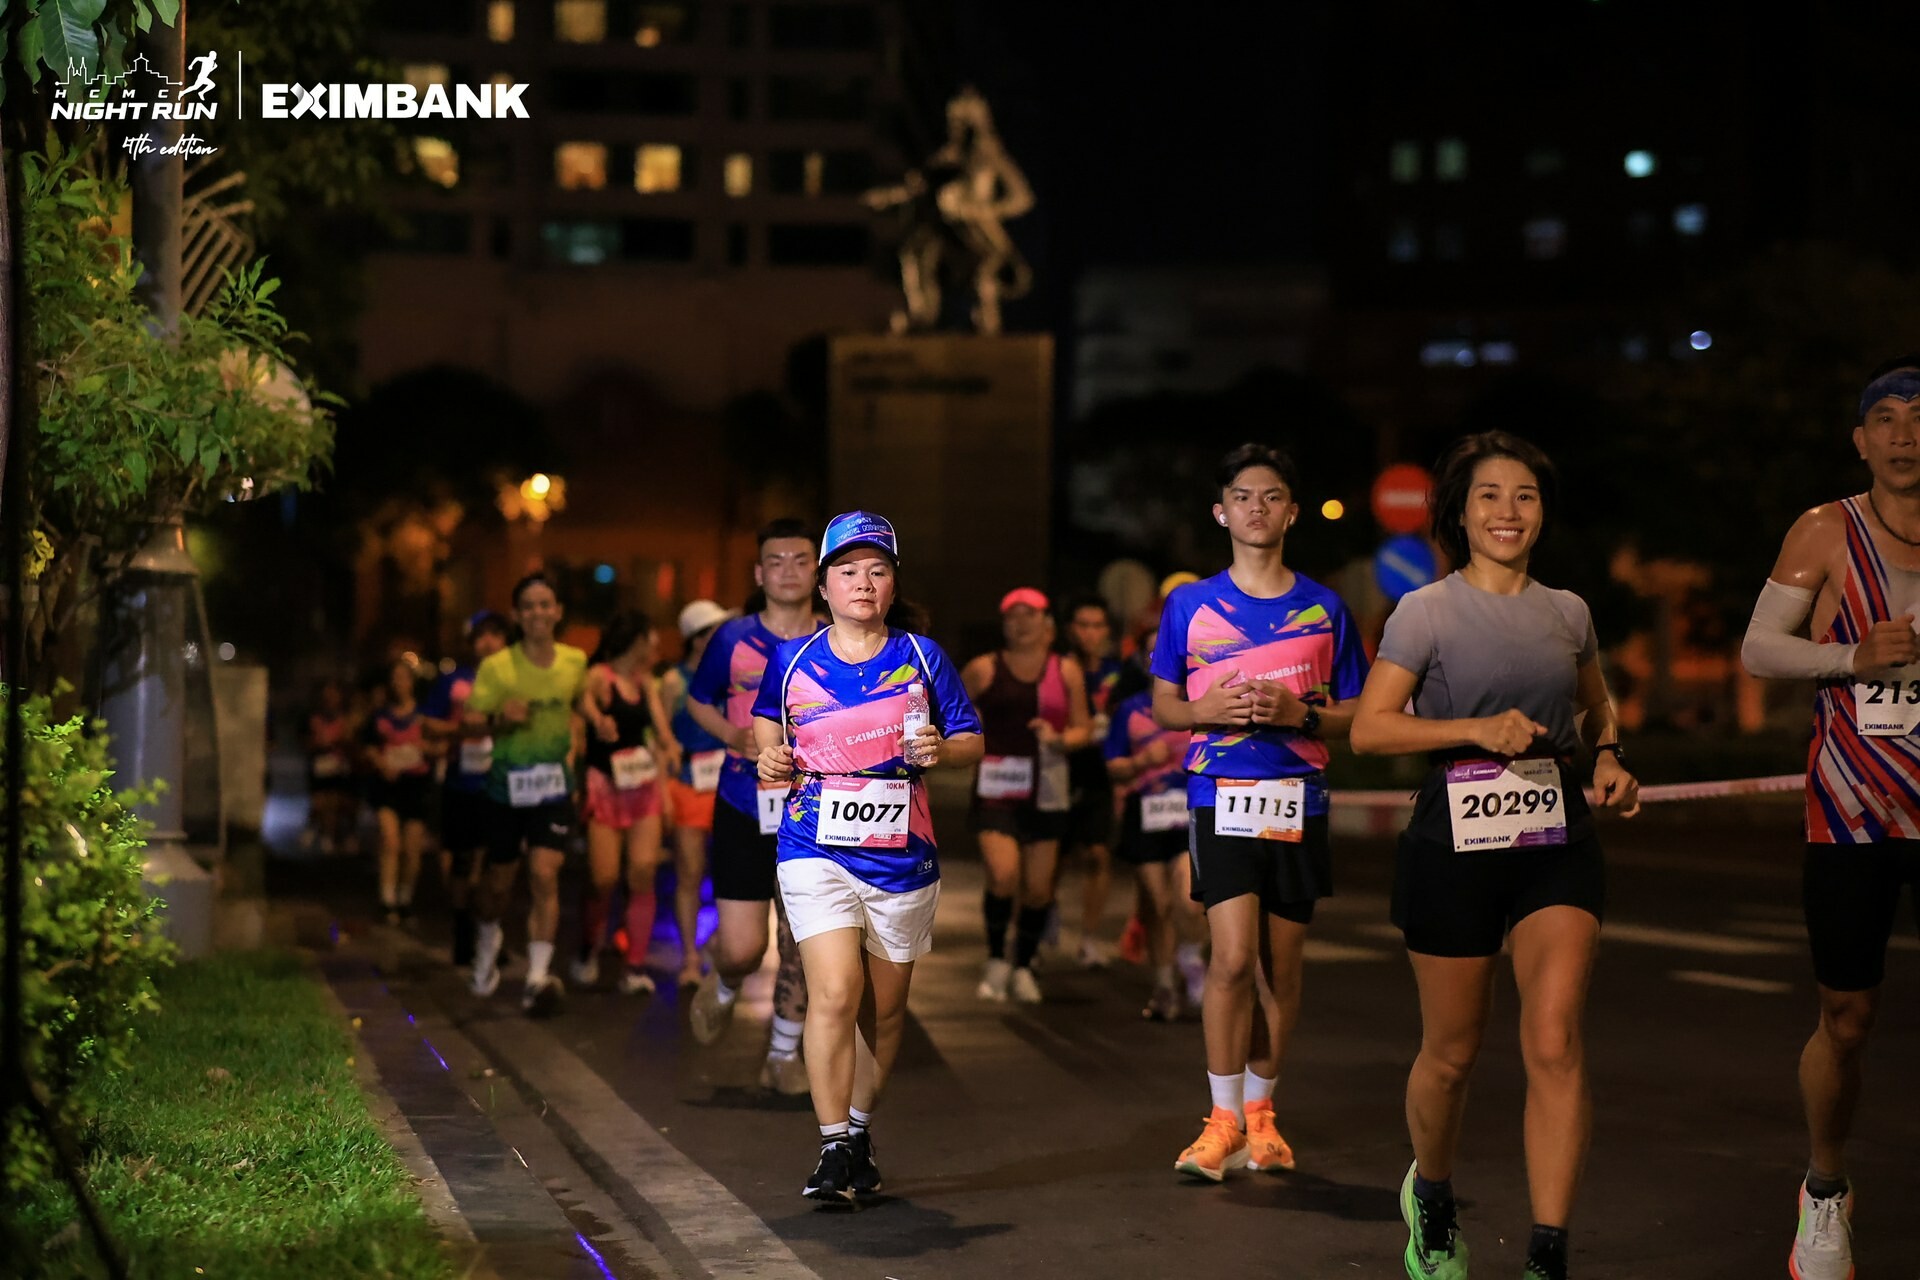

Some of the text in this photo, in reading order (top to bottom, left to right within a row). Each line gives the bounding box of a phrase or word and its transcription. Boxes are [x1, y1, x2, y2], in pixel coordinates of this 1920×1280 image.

[1255, 663, 1312, 681] EXIMBANK
[1865, 680, 1920, 705] 213
[845, 723, 904, 746] EXIMBAN
[831, 800, 906, 822] 10077
[1228, 796, 1298, 818] 11115
[1461, 788, 1558, 819] 20299
[825, 834, 861, 842] EXIMBANK
[1464, 835, 1511, 846] EXIMBANK
